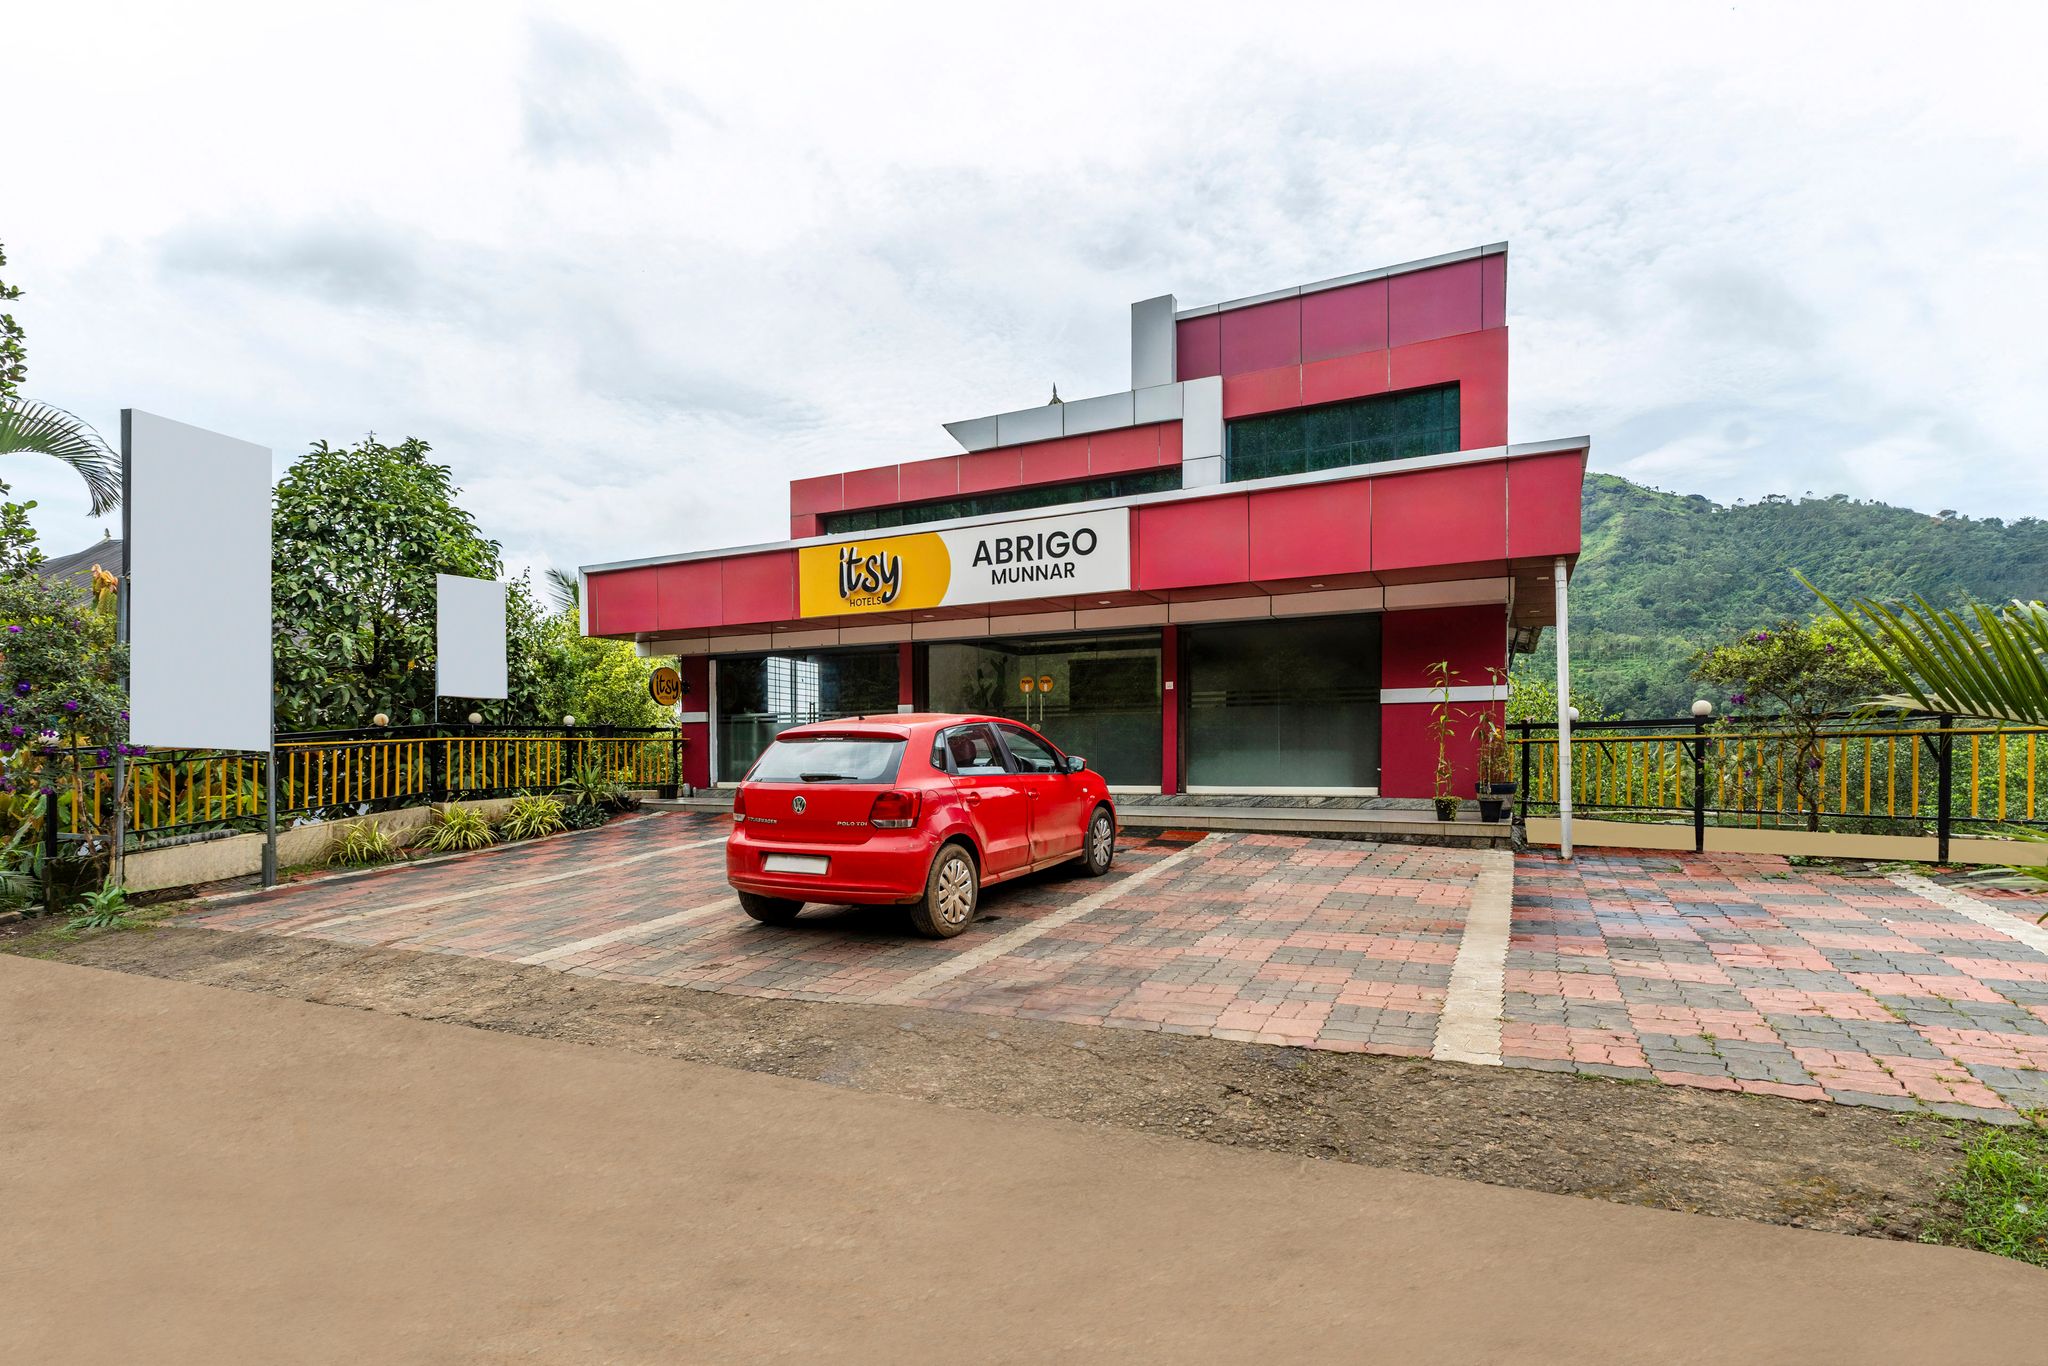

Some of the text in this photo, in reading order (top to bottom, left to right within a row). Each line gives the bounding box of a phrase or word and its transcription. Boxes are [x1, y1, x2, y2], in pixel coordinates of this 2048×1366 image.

[972, 528, 1097, 567] ABRIGO
[839, 547, 902, 604] itsy
[992, 562, 1075, 585] MUNNAR
[849, 597, 881, 607] HOTELS
